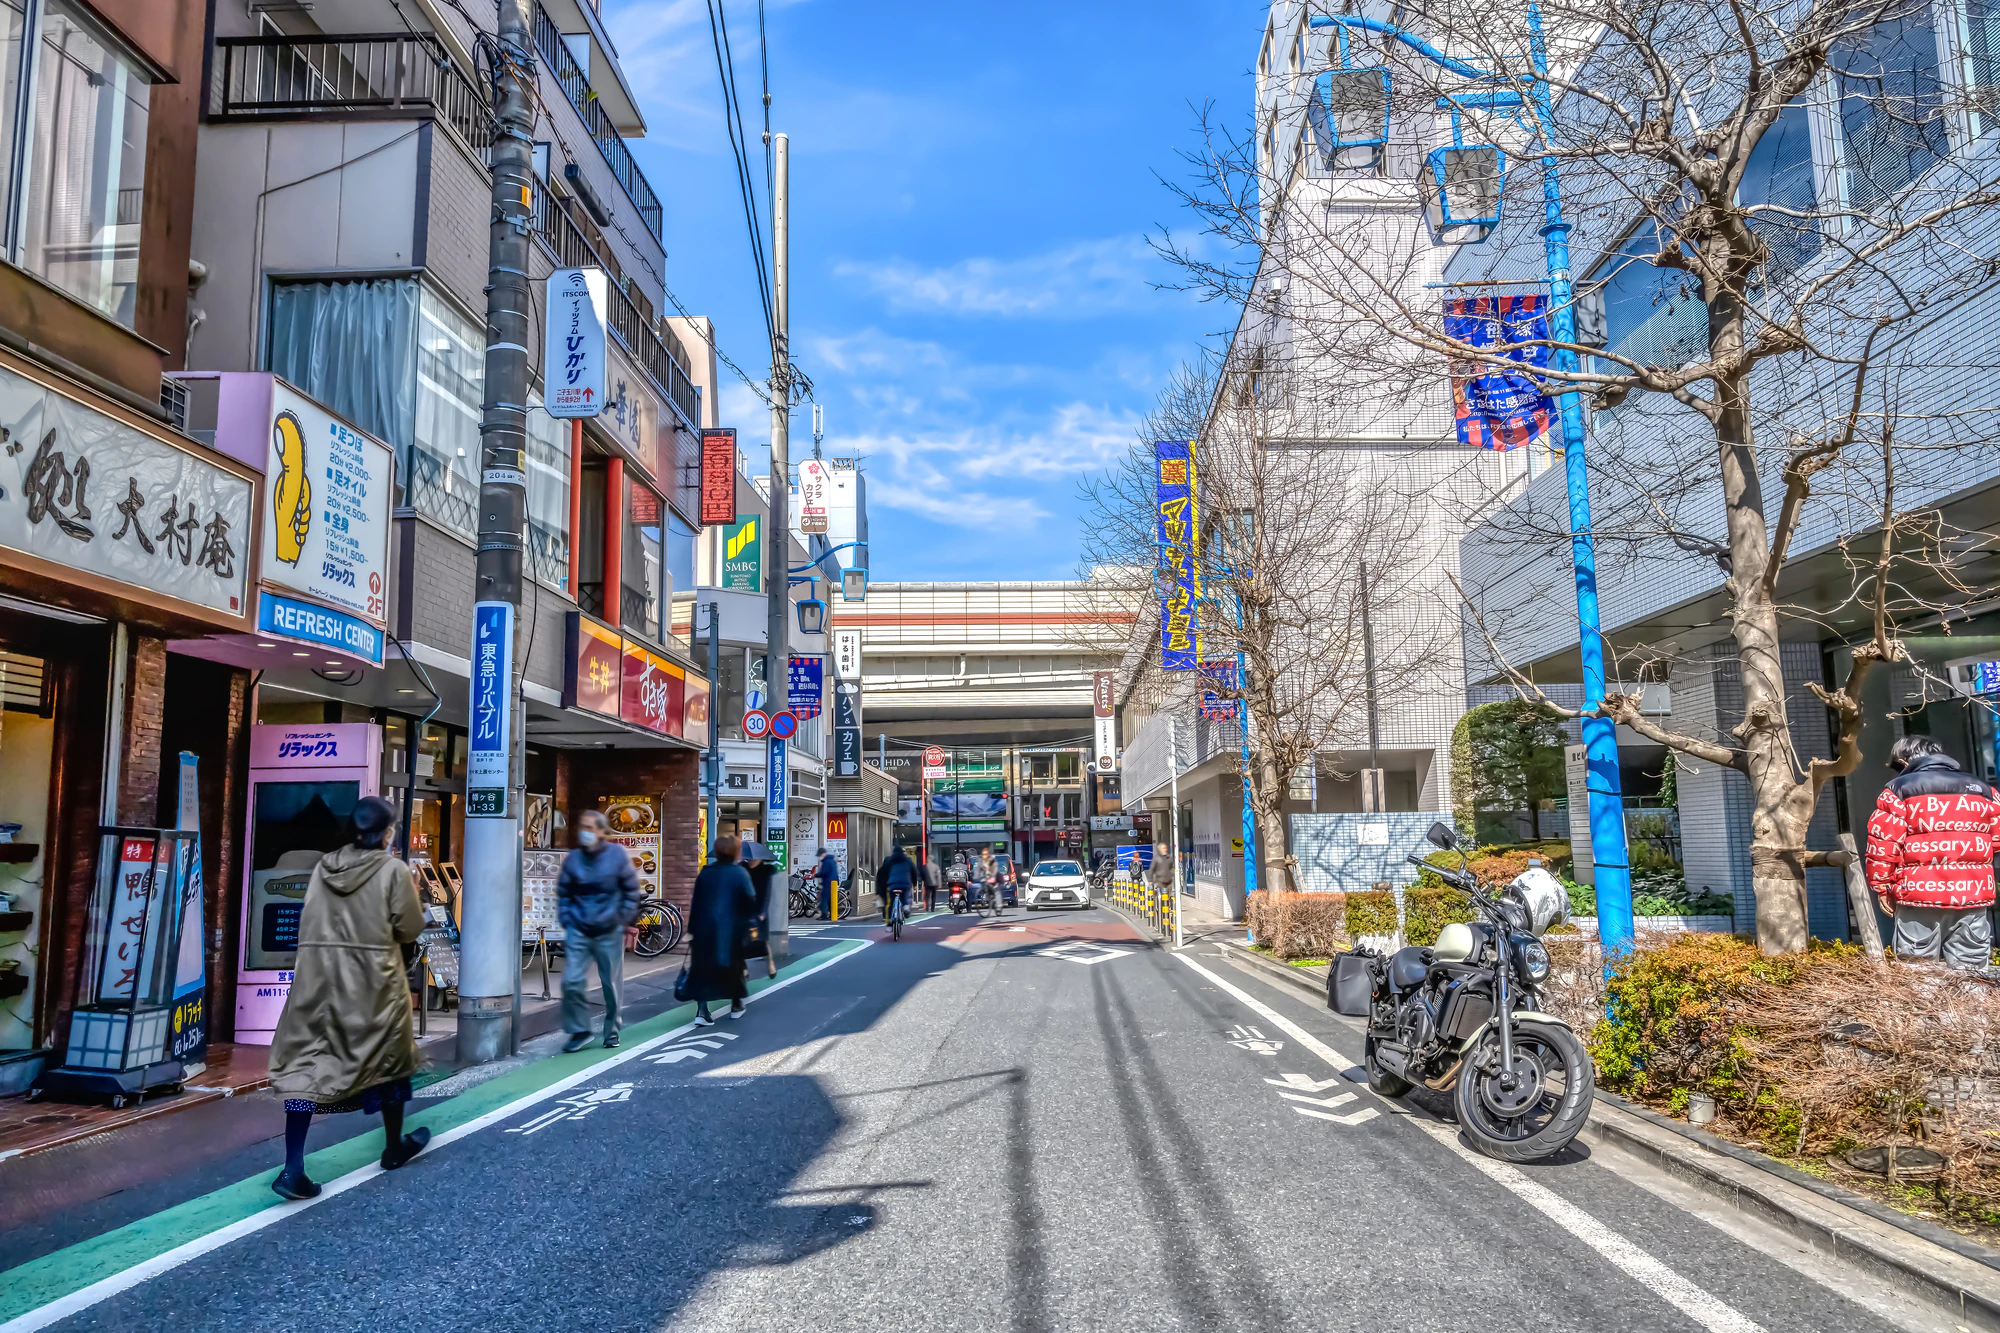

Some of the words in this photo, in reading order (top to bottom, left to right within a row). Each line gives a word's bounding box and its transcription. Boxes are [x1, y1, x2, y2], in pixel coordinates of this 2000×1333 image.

[571, 299, 580, 334] イッツコム
[565, 335, 586, 385] ひかり
[338, 425, 364, 453] 足つぼ
[334, 469, 367, 498] 足オイル
[806, 483, 814, 505] カフェ
[815, 475, 823, 499] サクラ
[112, 476, 235, 579] 大村庵
[332, 512, 349, 534] 全身
[322, 561, 355, 588] リラックス
[725, 561, 757, 572] SMBC
[367, 595, 382, 616] 2F
[273, 604, 343, 641] REFRESH
[345, 623, 375, 654] CENTER
[589, 656, 611, 695] 牛丼
[477, 643, 498, 740] 東急リバブル
[640, 653, 668, 728] すき家
[1100, 676, 1110, 709] Watts
[748, 717, 764, 730] 30
[278, 741, 337, 758] リラックス
[865, 759, 910, 767] YOHIDA
[735, 776, 741, 786] R
[773, 756, 782, 804] 東急リバブル
[472, 803, 495, 811] 1-33
[1927, 796, 1951, 816] By
